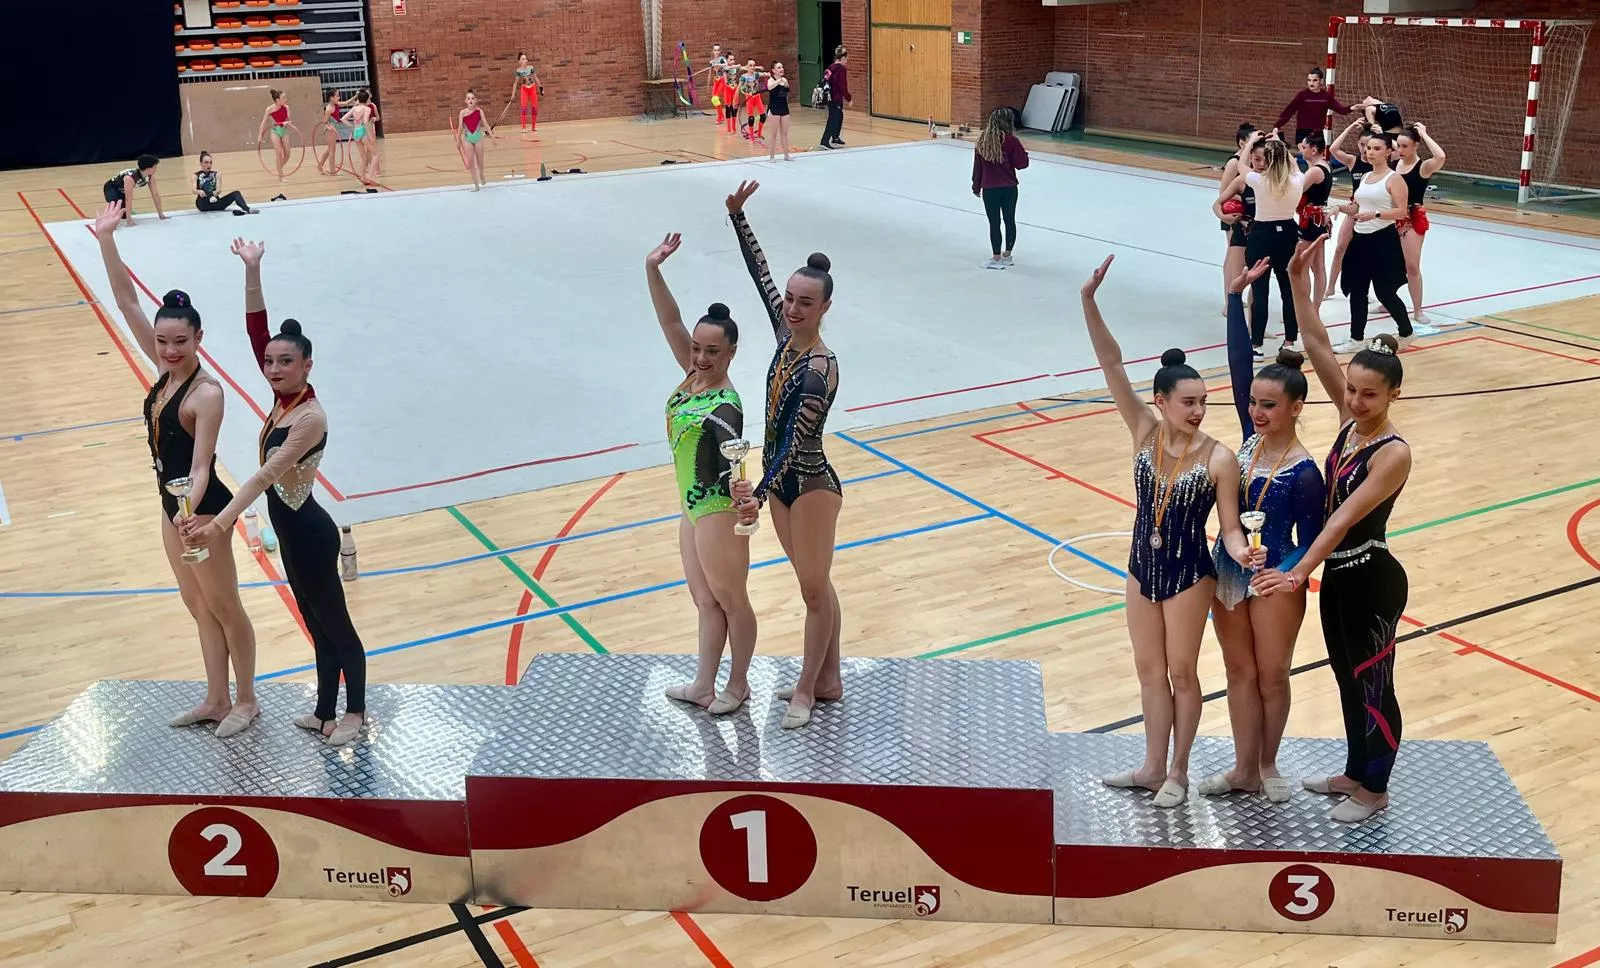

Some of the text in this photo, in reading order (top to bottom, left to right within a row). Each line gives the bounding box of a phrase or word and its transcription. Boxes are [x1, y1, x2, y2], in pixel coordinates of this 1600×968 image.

[200, 823, 248, 876] 2
[730, 810, 768, 883] 1
[323, 868, 385, 884] Teruel
[846, 886, 912, 903] Teruel
[1284, 874, 1320, 915] 3
[1385, 908, 1443, 923] Teruel
